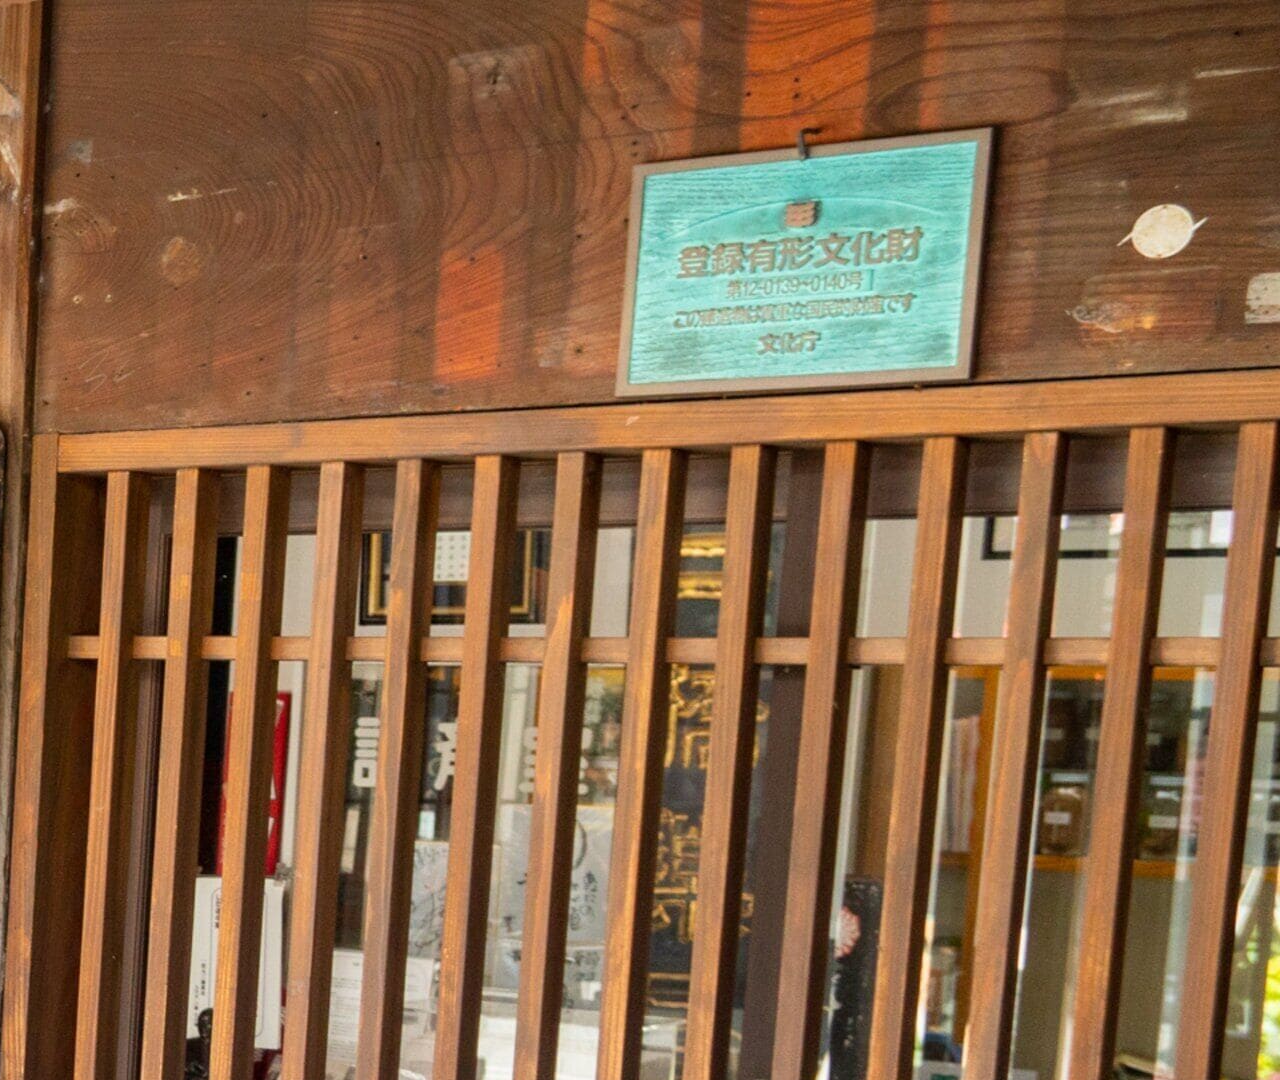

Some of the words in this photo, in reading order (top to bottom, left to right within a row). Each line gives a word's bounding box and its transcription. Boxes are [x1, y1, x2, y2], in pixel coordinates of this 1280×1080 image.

[677, 225, 923, 279] 登録有形文化財
[757, 330, 821, 356] 文化庁
